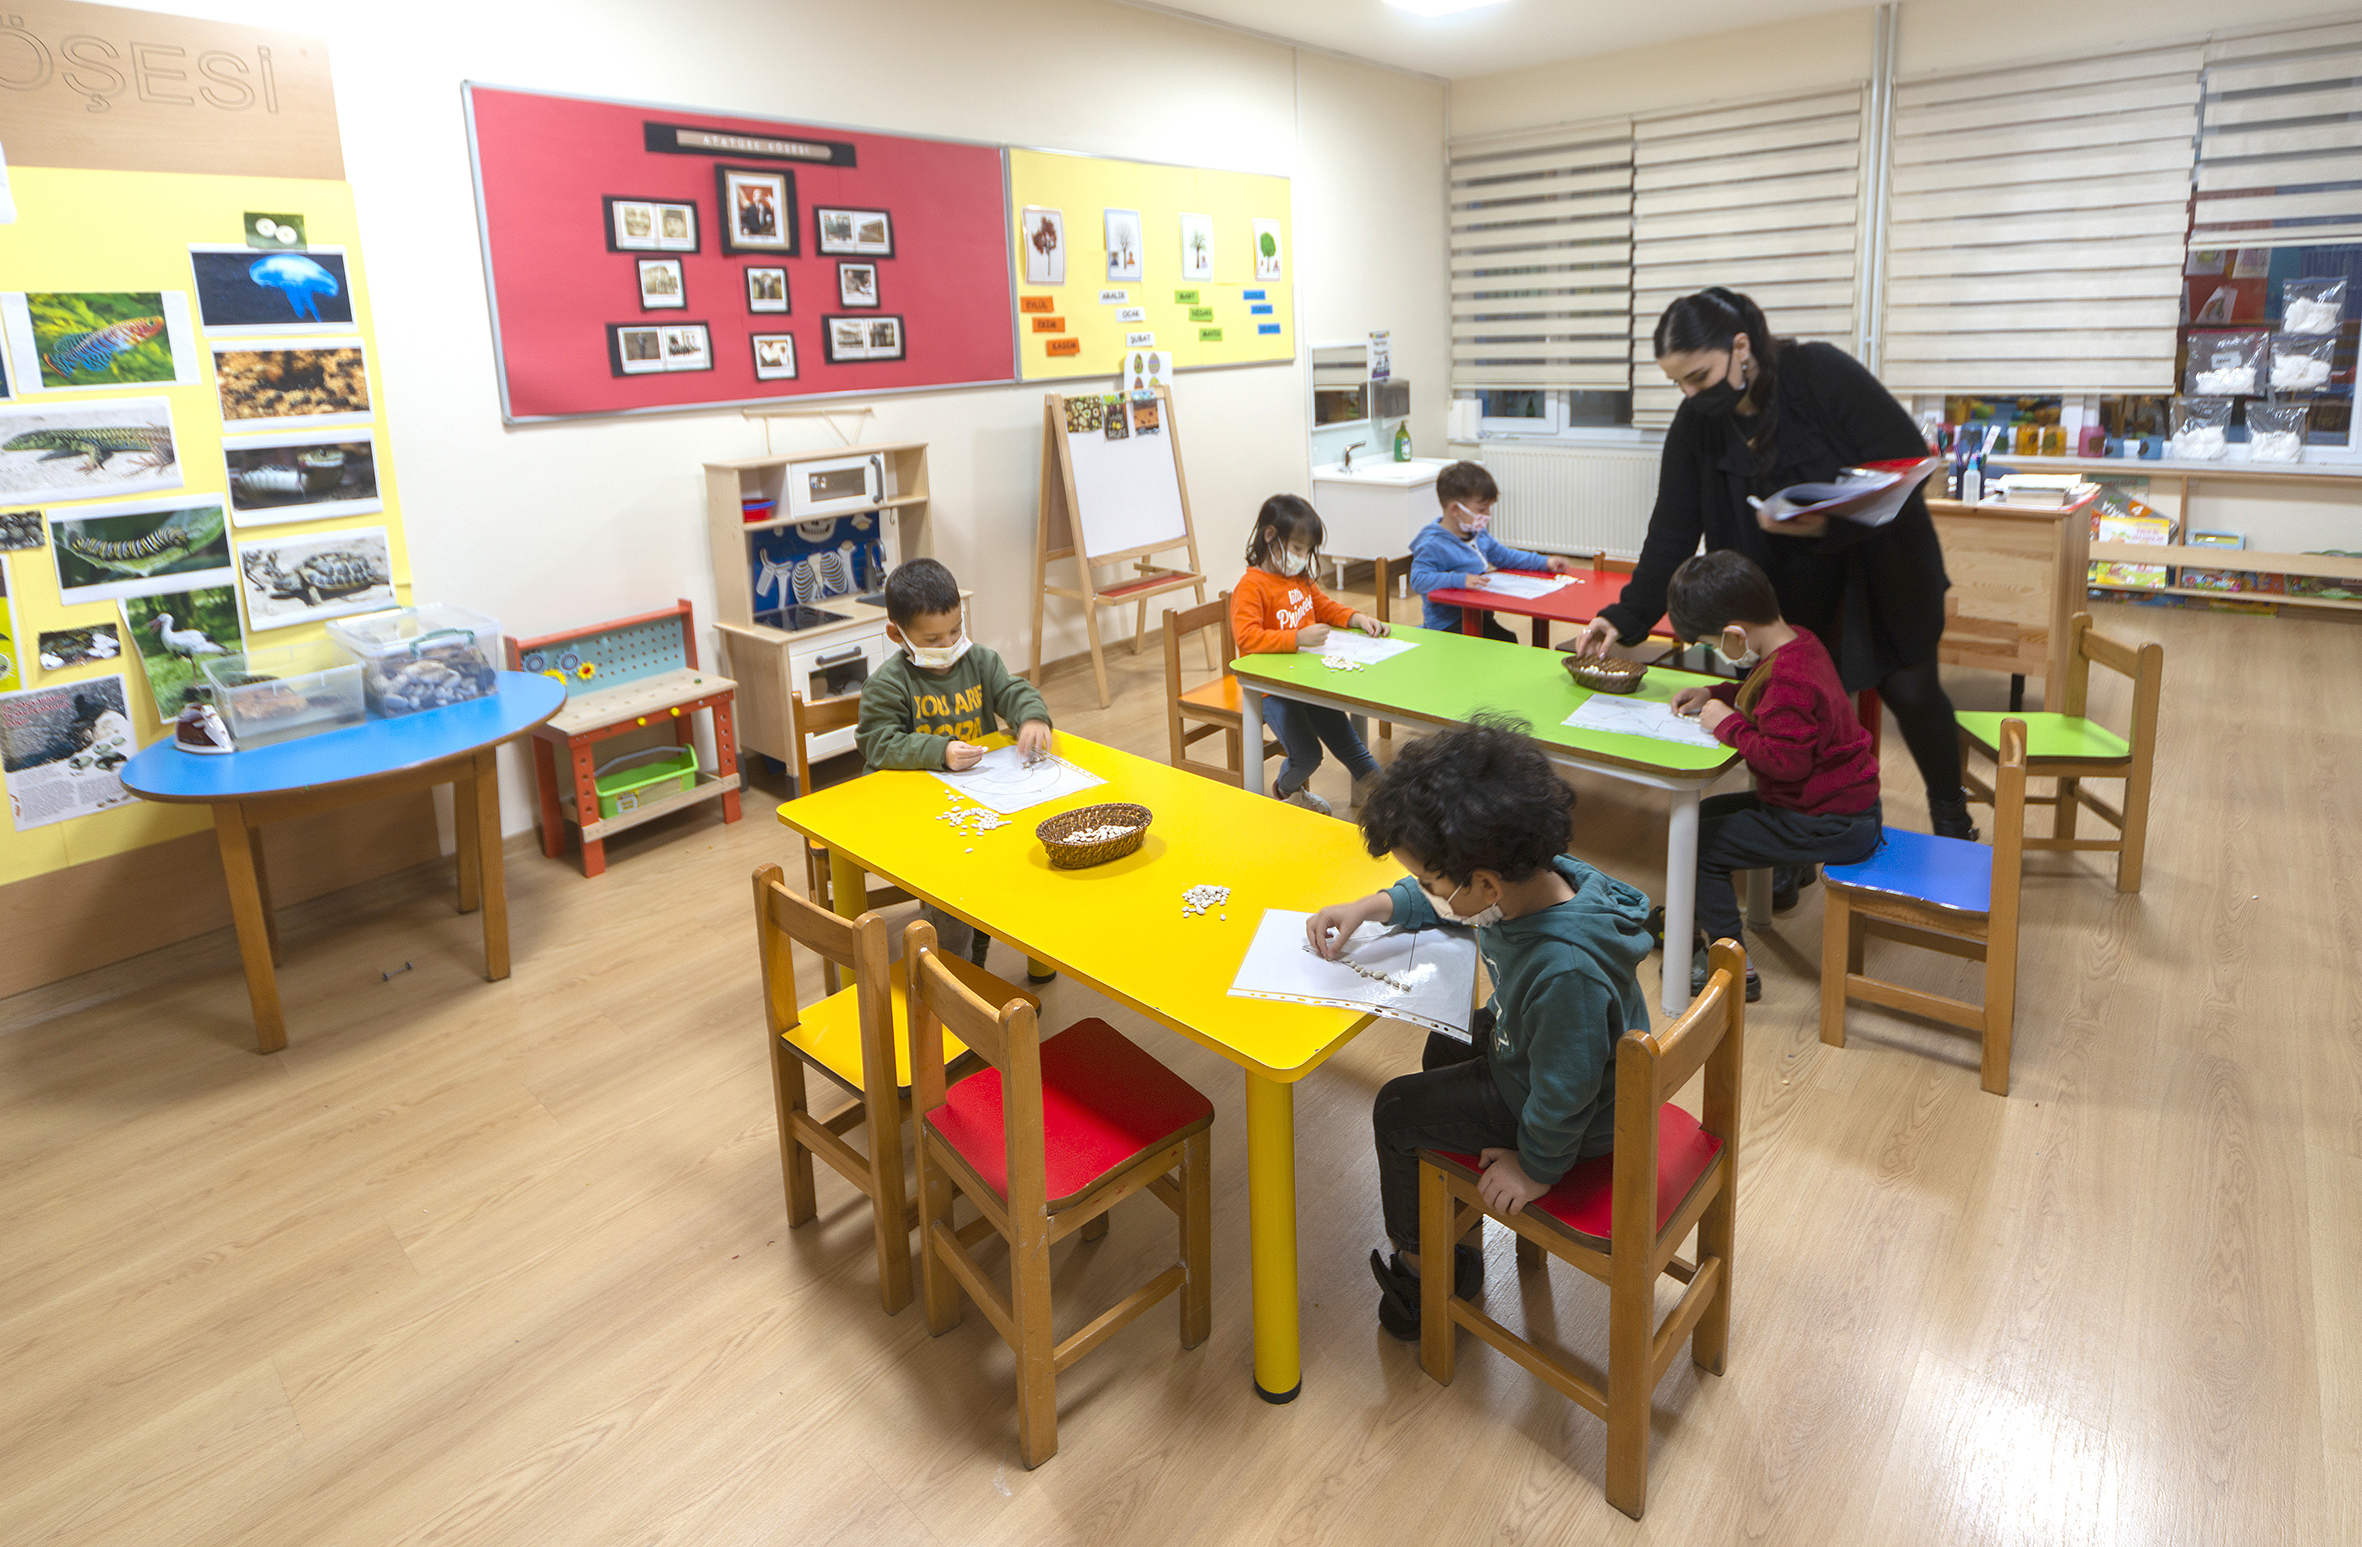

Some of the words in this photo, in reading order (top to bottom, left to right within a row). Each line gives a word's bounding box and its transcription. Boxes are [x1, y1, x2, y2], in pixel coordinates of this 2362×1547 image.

[703, 135, 760, 150] ATATÜRK
[1102, 290, 1126, 300] ARALIK
[1122, 309, 1140, 319] OCAK
[2131, 505, 2145, 516] 4
[913, 695, 950, 719] YOU
[955, 684, 982, 715] ARE
